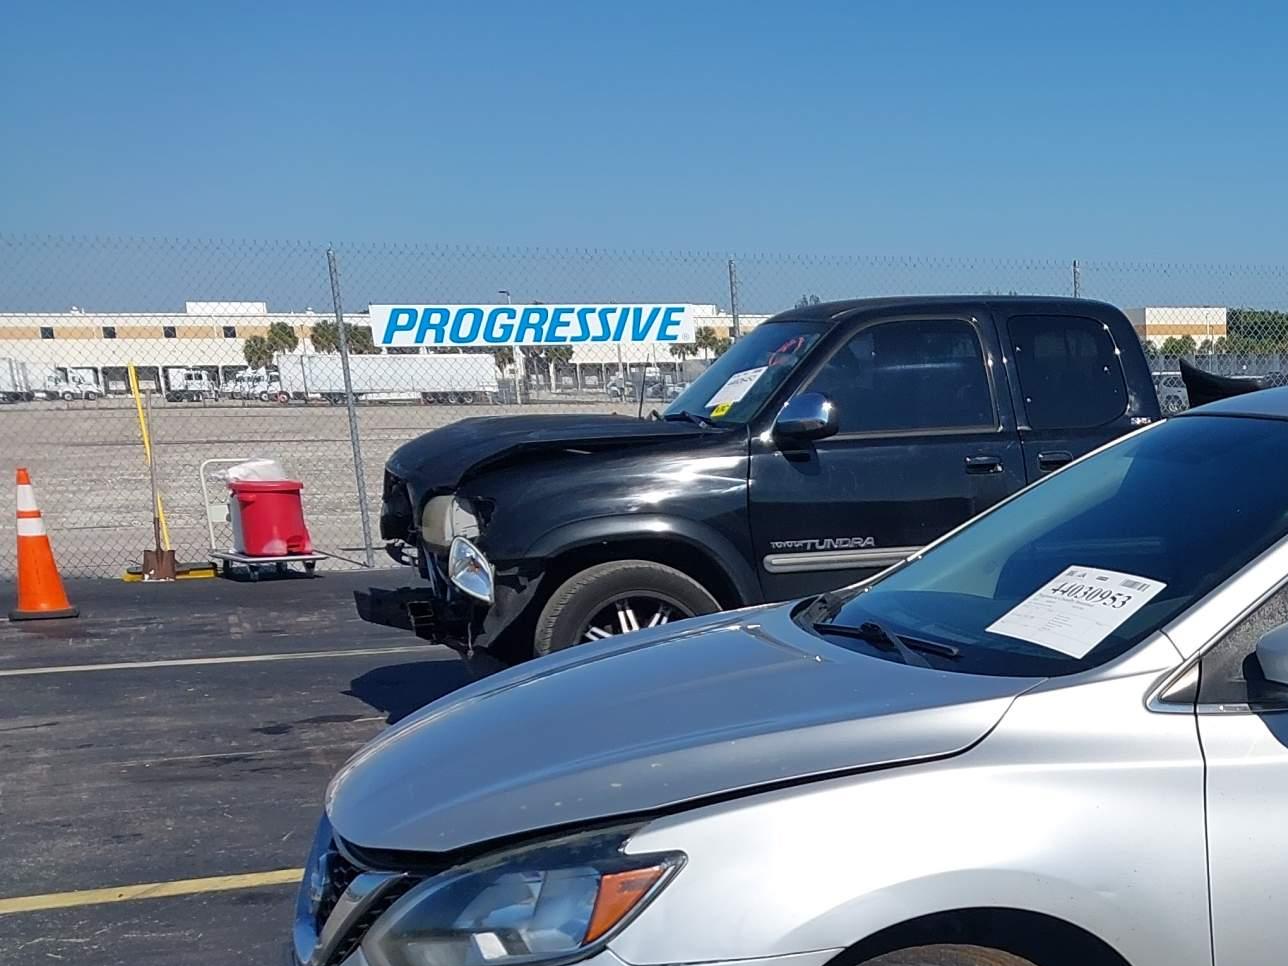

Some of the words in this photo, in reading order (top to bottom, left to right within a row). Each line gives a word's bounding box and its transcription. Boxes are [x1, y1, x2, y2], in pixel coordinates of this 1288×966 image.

[382, 307, 685, 344] PROGRESSIVE
[803, 537, 875, 550] TUNDRA
[1051, 582, 1132, 608] 44030953
